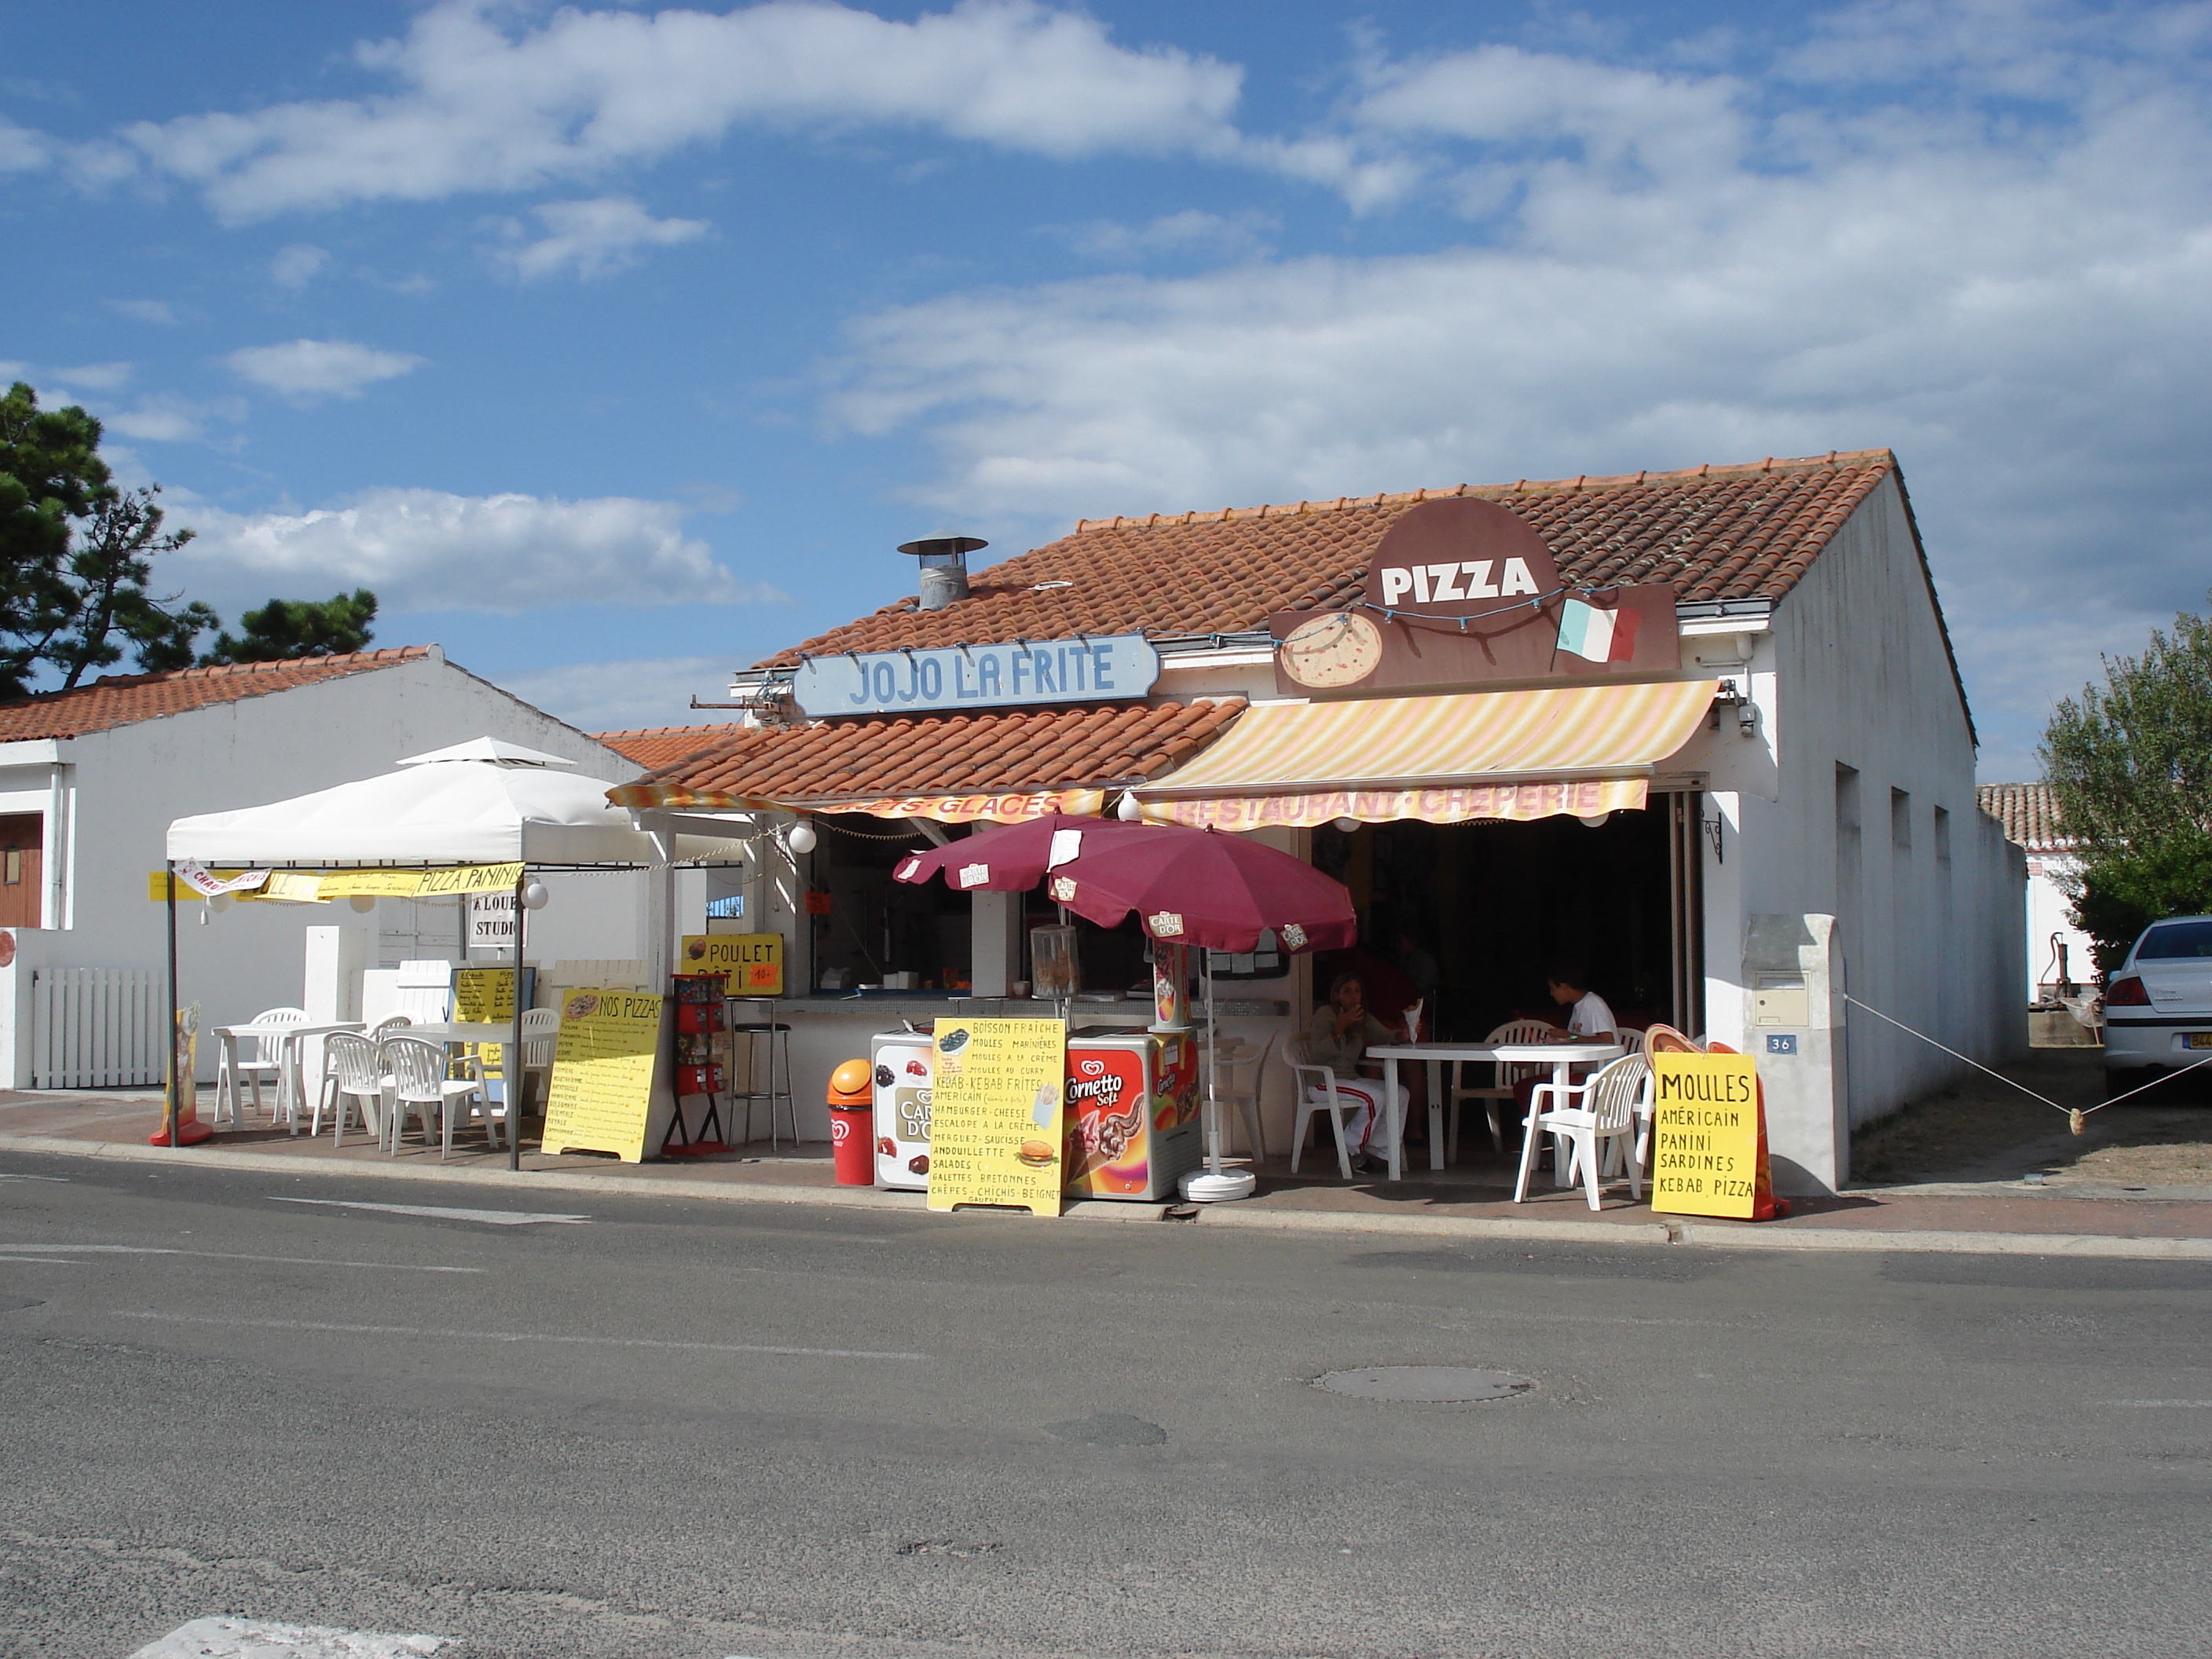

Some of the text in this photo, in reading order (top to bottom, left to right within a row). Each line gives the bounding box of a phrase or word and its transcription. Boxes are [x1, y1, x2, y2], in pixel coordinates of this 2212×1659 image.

[1380, 556, 1540, 606] PIZZA
[849, 643, 1115, 705] JOJO LA FRITE
[938, 794, 1062, 816] GLACES
[1178, 781, 1602, 823] RESTAURANT CREPERIE
[418, 869, 460, 893] PIZZA
[467, 866, 525, 889] PANINIS
[484, 895, 516, 910] LOUE
[1151, 915, 1180, 927] CARTE
[1159, 923, 1181, 934] D'OR
[710, 944, 773, 962] POULET
[599, 996, 661, 1018] NOS PIZZAS
[972, 1020, 1010, 1034] BOISSON
[972, 1038, 1002, 1048] MOULES
[1772, 1038, 1789, 1050] 36
[1020, 1067, 1045, 1075] CURRY
[1007, 1077, 1042, 1092] FRITES
[1064, 1073, 1122, 1105] Cornetto
[1661, 1074, 1750, 1103] MOULES
[935, 1090, 982, 1102] AMERICAIN
[1097, 1093, 1119, 1108] Soft
[899, 1101, 932, 1121] CAR
[1660, 1106, 1739, 1127] AMÉRICAIN
[906, 1119, 932, 1141] D'O
[934, 1119, 978, 1129] ESCALOPE
[994, 1121, 1004, 1130] LA
[1661, 1130, 1712, 1152] PANINI
[932, 1146, 1005, 1157] ANDOUILLETTE
[932, 1159, 972, 1170] SALADES
[1660, 1153, 1734, 1172] SARDINES
[932, 1173, 1036, 1186] GALETTES BRETONNES
[1714, 1175, 1753, 1198] PIZZA
